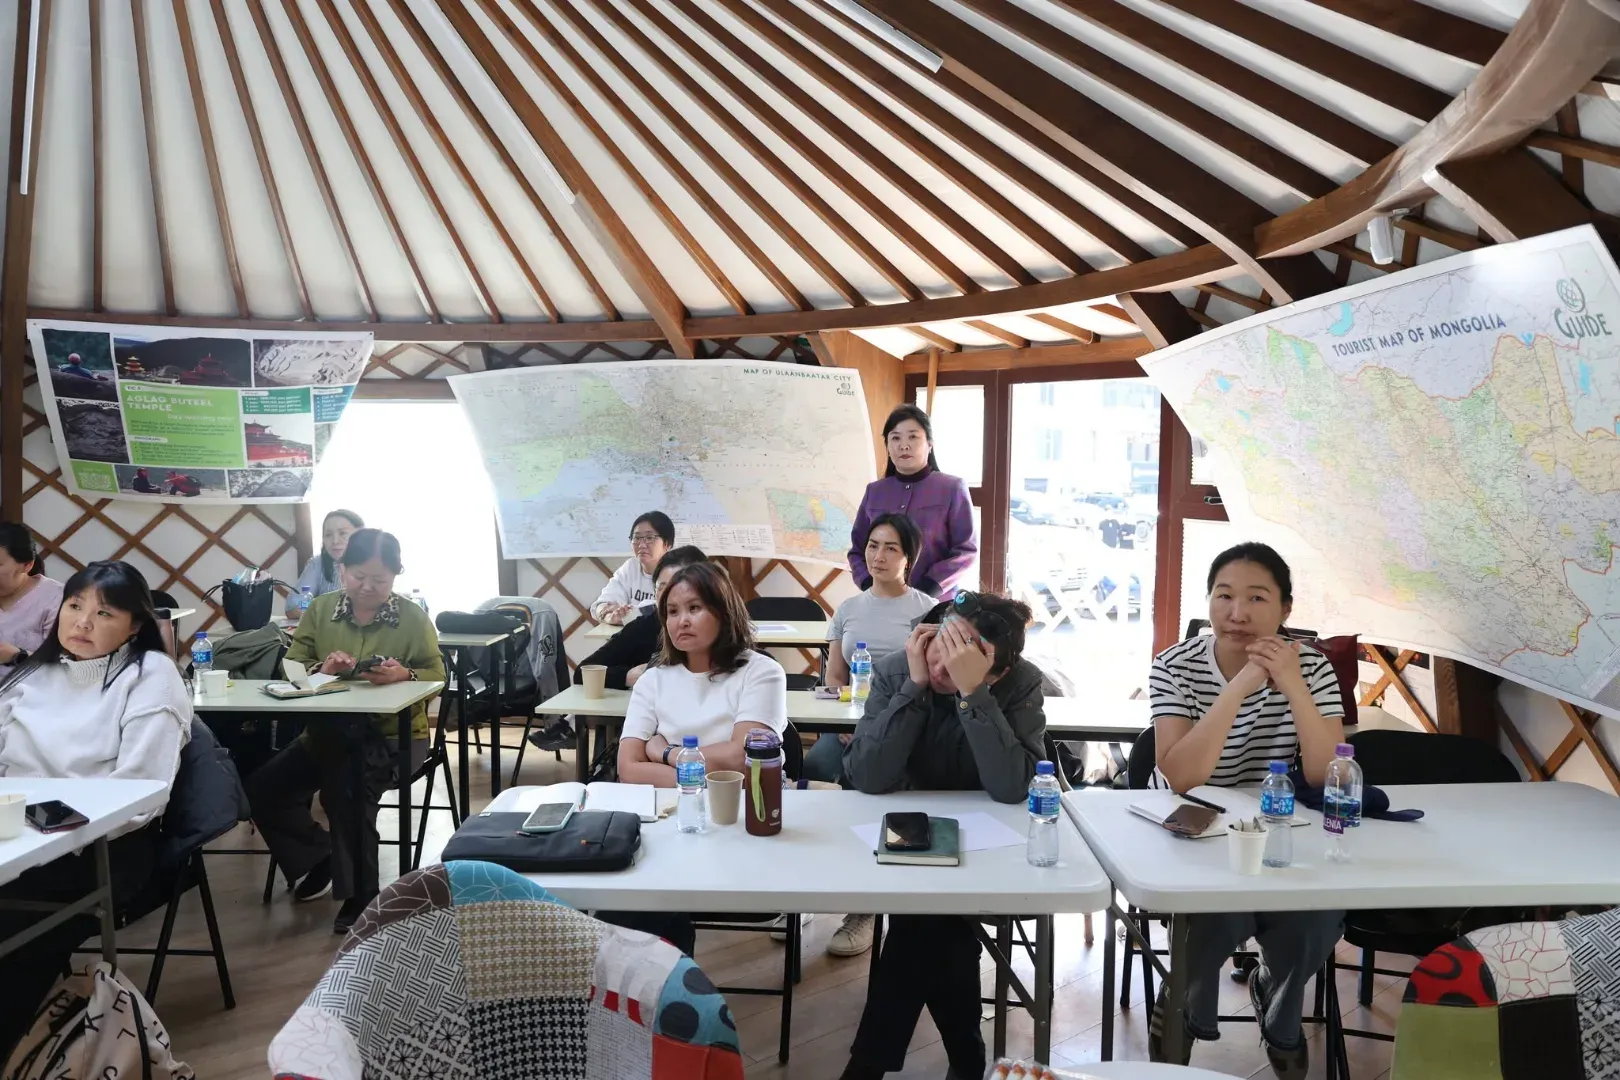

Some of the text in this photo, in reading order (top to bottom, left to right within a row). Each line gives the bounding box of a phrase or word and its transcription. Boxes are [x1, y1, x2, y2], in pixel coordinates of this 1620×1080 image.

[1554, 308, 1612, 339] GUIDE
[1332, 313, 1507, 357] TOURIST MAP OF MONGOLIA
[775, 370, 831, 380] ULAANBAATAR
[128, 402, 172, 412] TEMPLE
